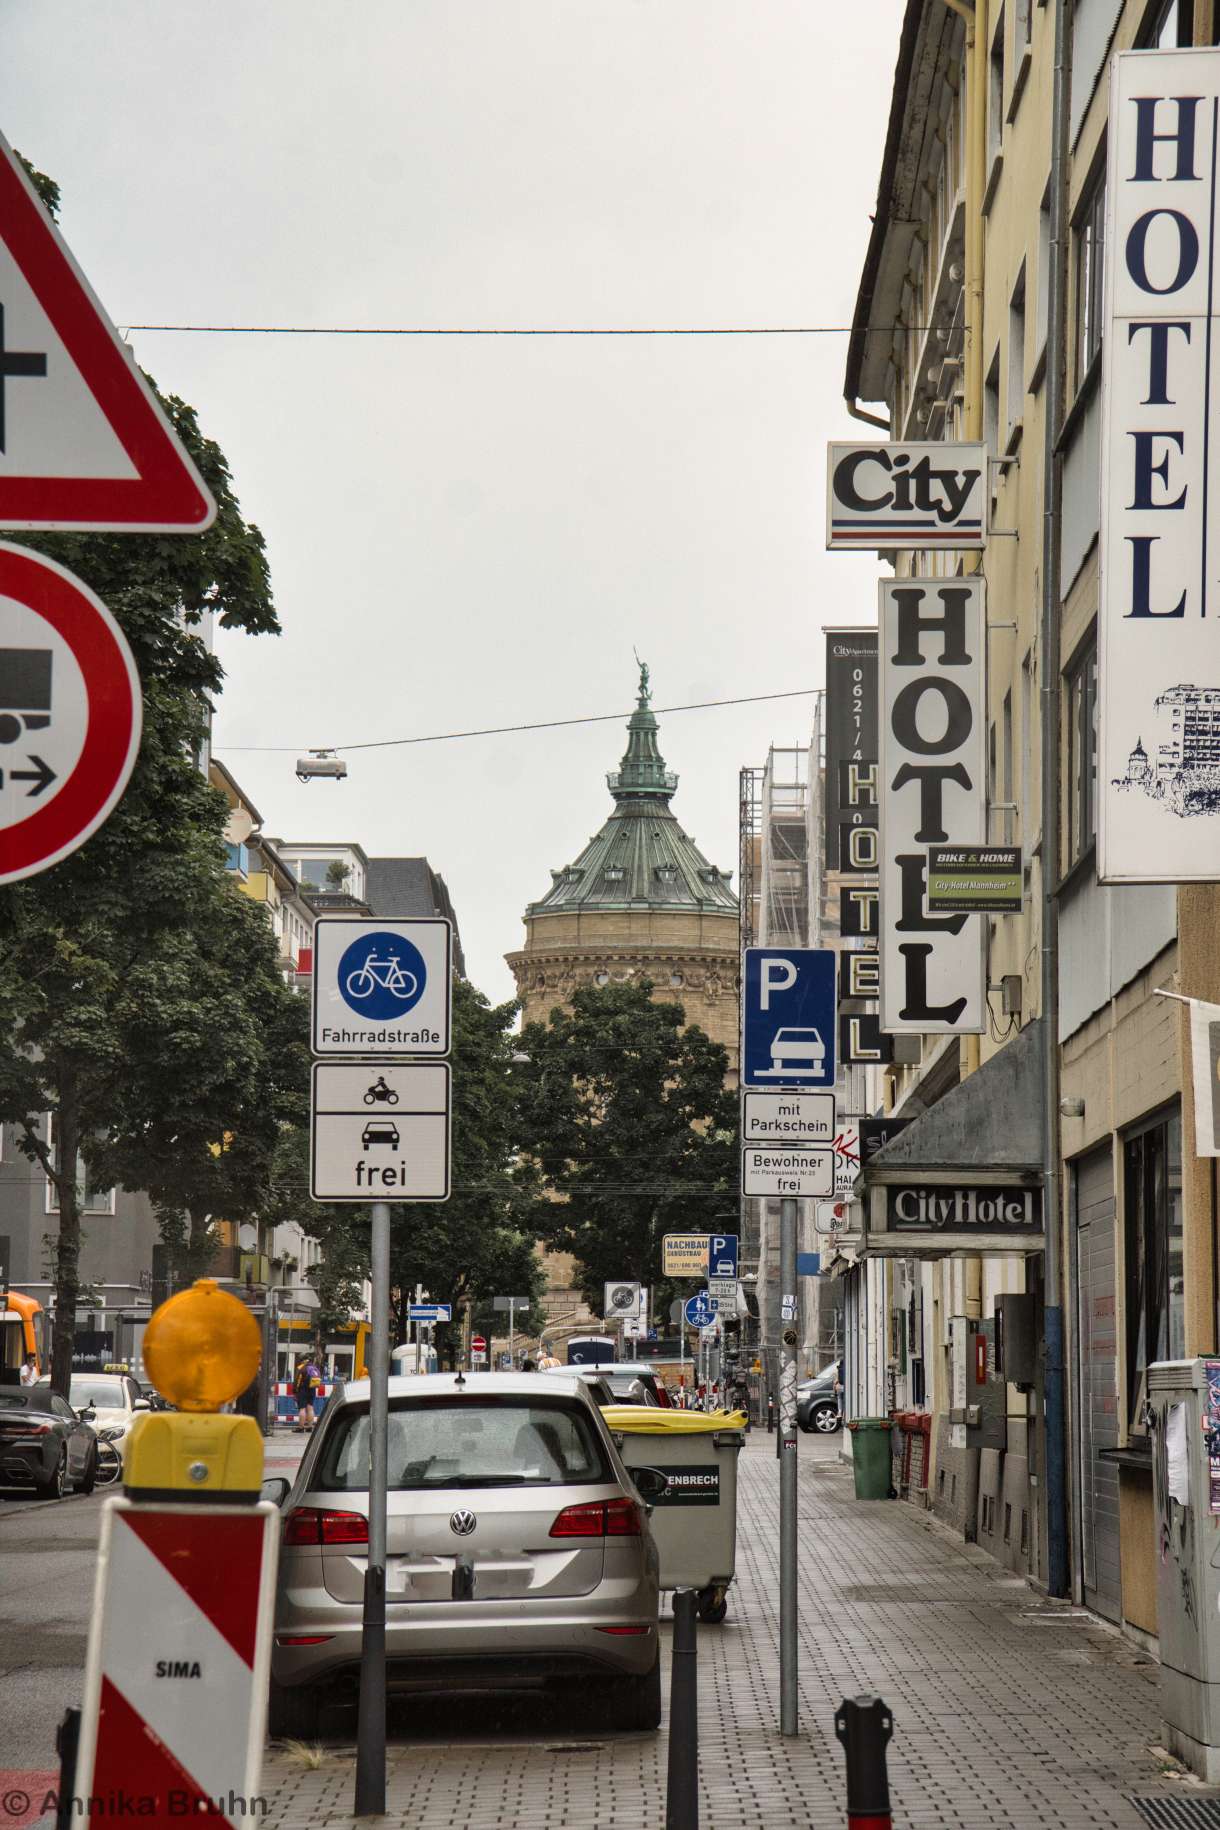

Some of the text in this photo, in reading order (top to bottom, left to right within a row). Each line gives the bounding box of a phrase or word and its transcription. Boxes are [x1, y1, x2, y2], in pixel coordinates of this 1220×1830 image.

[1122, 96, 1206, 617] HOTEL
[833, 448, 981, 522] City
[937, 854, 1016, 863] BIKE & HOME
[760, 958, 798, 1010] P
[322, 1028, 440, 1043] Fahrradstraße
[779, 1102, 801, 1116] mit
[751, 1118, 828, 1132] Parkschein
[753, 1154, 824, 1168] Bewohner
[355, 1160, 406, 1186] frei
[777, 1178, 801, 1191] frei
[667, 1240, 708, 1250] NACHBAU
[713, 1237, 726, 1255] P
[156, 1661, 201, 1679] SIMA
